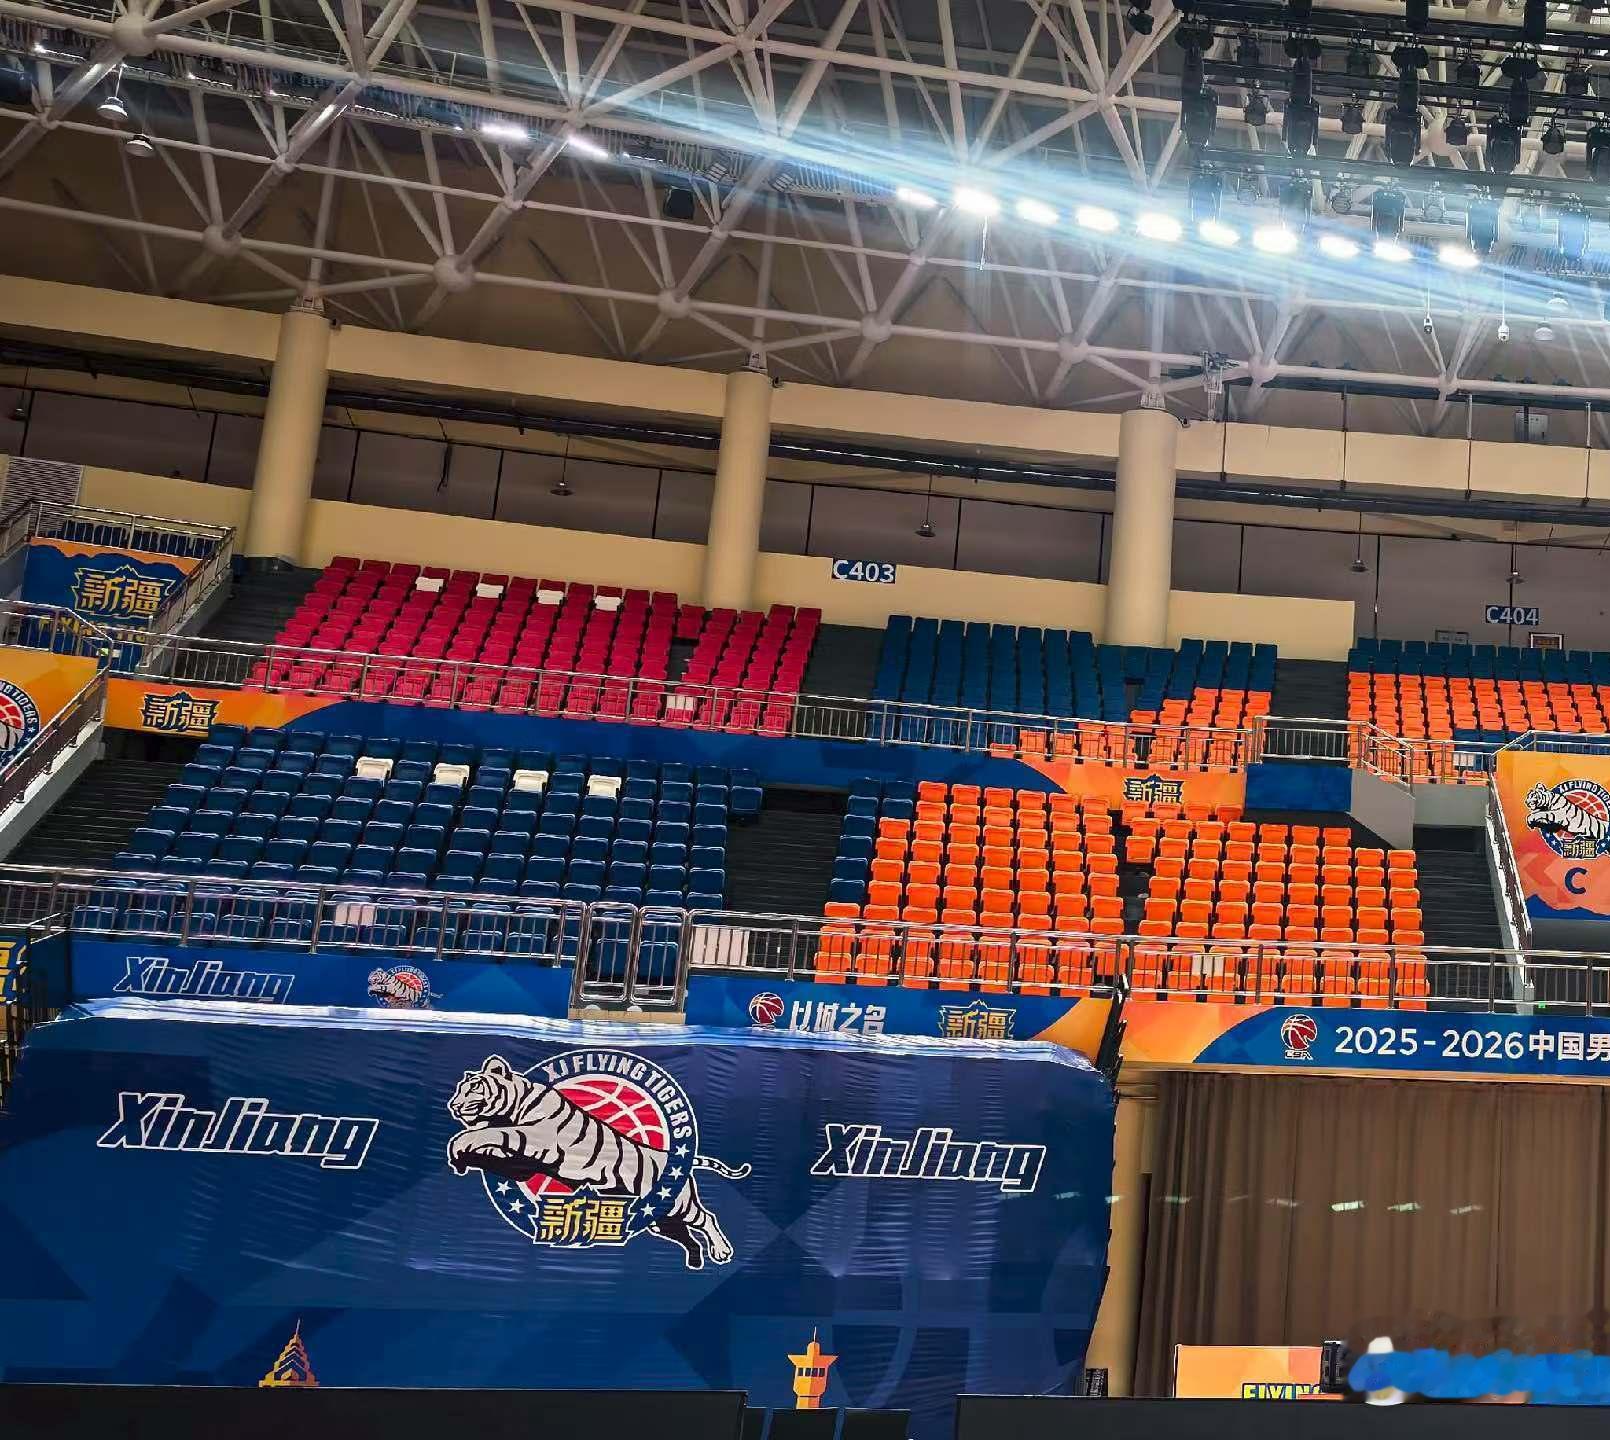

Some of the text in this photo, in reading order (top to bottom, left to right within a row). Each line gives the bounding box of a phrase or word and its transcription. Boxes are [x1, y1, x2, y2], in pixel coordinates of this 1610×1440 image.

[833, 559, 895, 582] C403
[80, 572, 164, 614] 新疆
[1486, 606, 1538, 626] C404
[144, 695, 212, 730] 新疆
[1564, 867, 1588, 895] C
[113, 956, 295, 1004] XinJiang
[789, 1000, 888, 1035] 以城之名
[542, 1053, 693, 1140] XJ FLYING TIGERS
[97, 1092, 380, 1169] XinJiang
[810, 1123, 1047, 1192] XinJiang
[540, 1195, 627, 1242] 新疆
